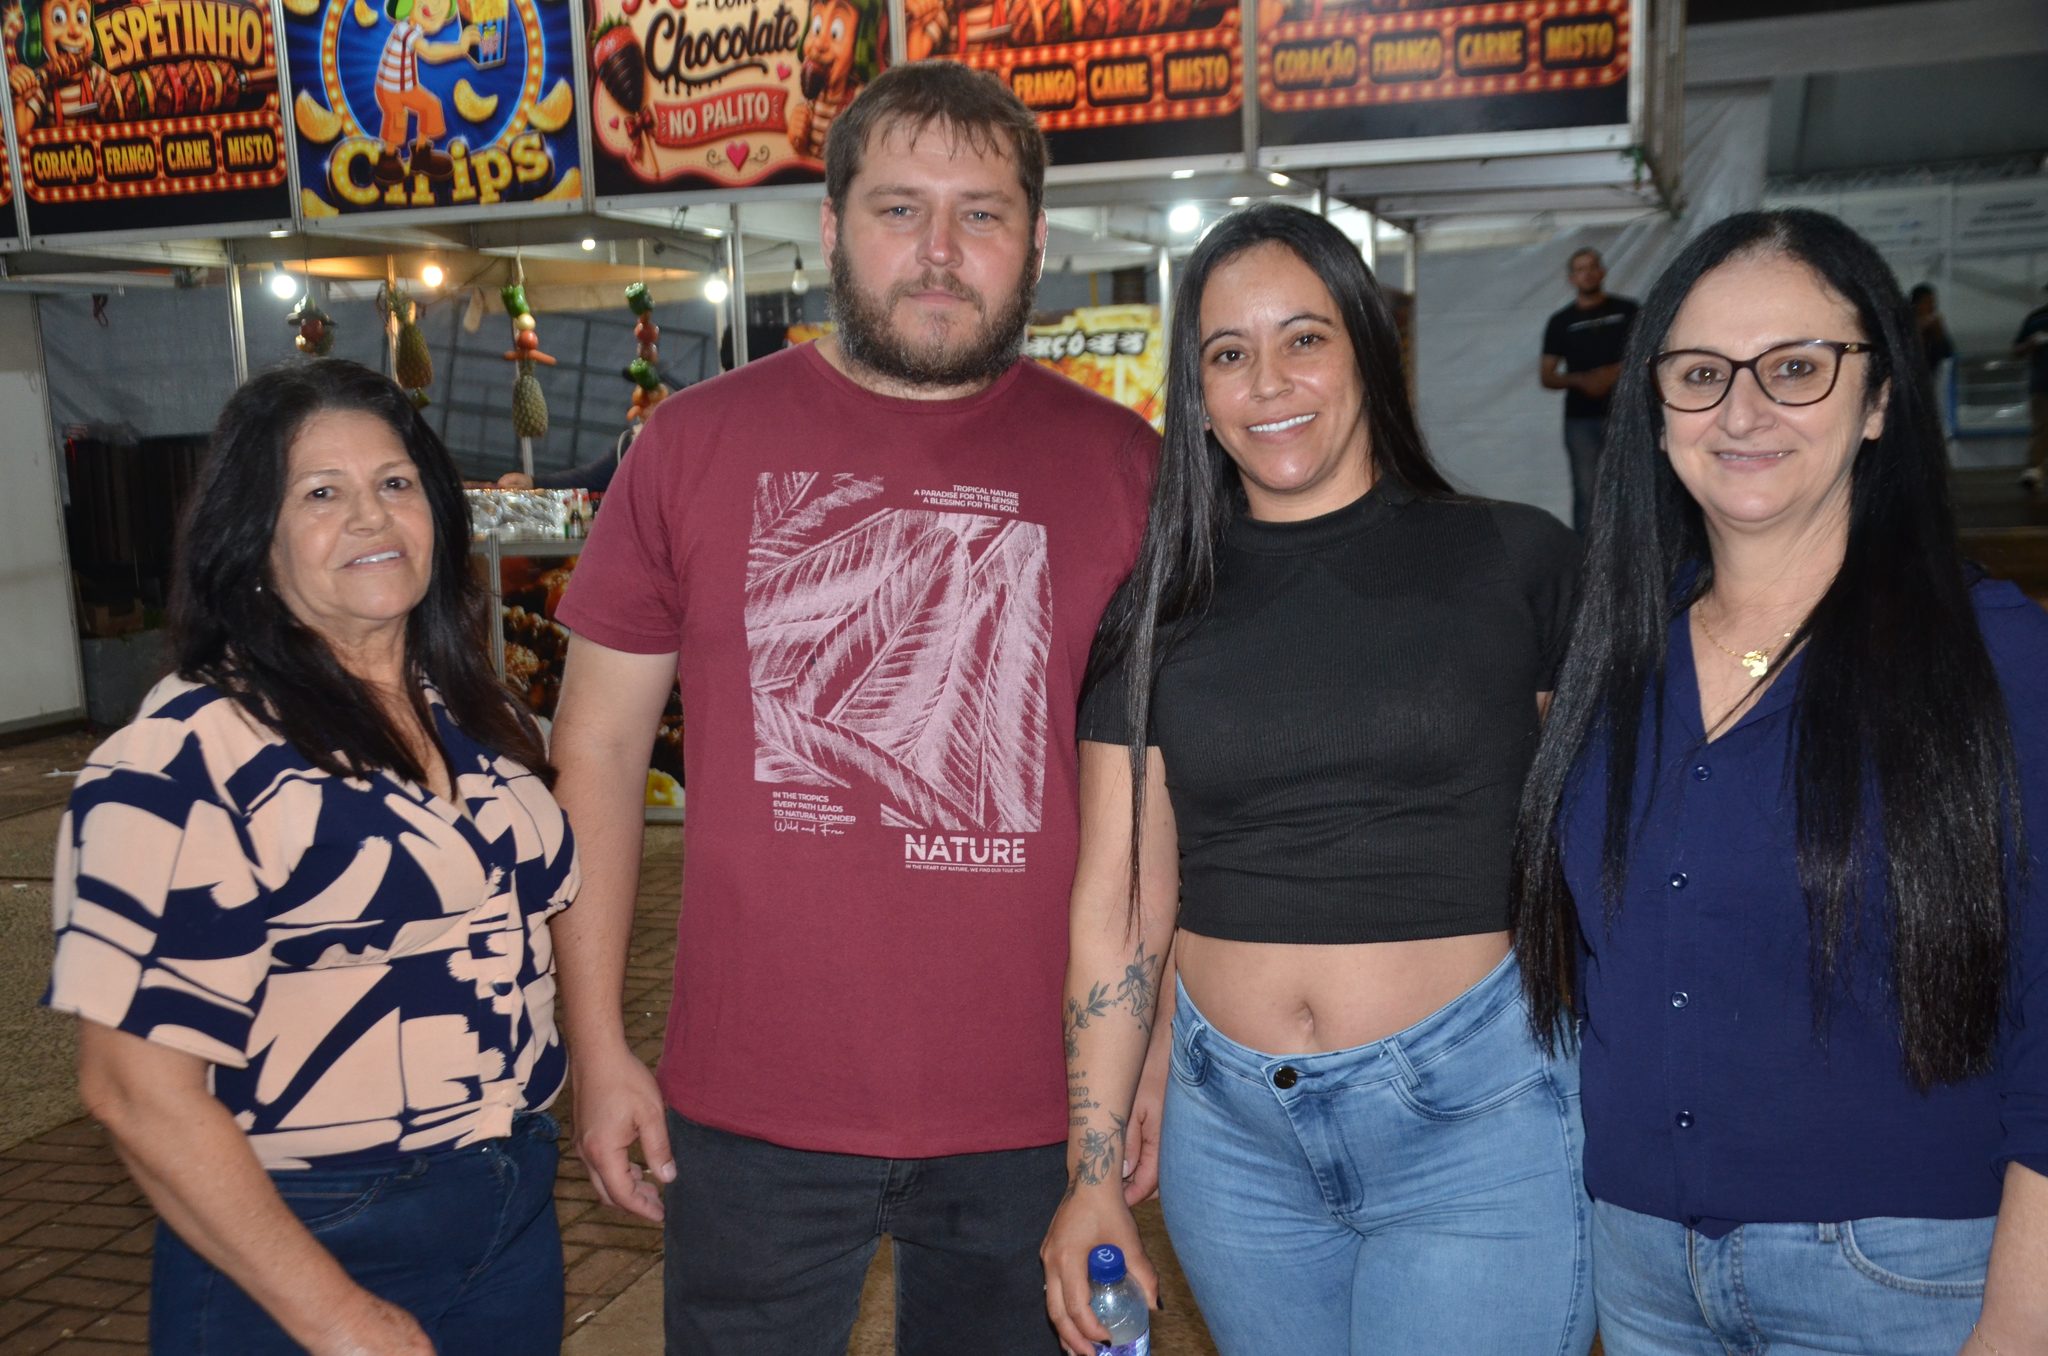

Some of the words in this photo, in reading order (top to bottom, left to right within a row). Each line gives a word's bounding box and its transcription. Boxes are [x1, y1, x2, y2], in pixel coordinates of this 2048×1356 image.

[95, 0, 263, 71] ESPETINHO
[645, 5, 799, 84] Chocolate
[1274, 39, 1356, 86] CORAÇÃO
[1372, 36, 1441, 76] FRANGO
[1458, 28, 1523, 66] CARNE
[1545, 22, 1614, 60] MISTO
[1013, 69, 1076, 104] FRANGO
[1089, 62, 1148, 100] CARNE
[1167, 54, 1229, 92] MISTO
[669, 107, 697, 138] NO
[702, 91, 770, 132] PALITO
[33, 144, 94, 183] CORAÇÃO
[104, 144, 155, 176] FRANGO
[166, 139, 212, 170] CARNE
[227, 134, 274, 166] MISTO
[920, 489, 958, 499] PARADISE
[959, 492, 975, 500] FOR
[976, 494, 991, 502] THE
[991, 496, 1019, 507] SENSES
[952, 484, 988, 494] TROPICAL
[990, 489, 1019, 499] NATURE
[922, 496, 929, 504] A
[930, 497, 966, 507] BLESSING
[967, 500, 983, 508] FOR
[984, 502, 998, 510] THE
[999, 504, 1019, 514] SOUL
[773, 800, 797, 808] EVERY
[798, 802, 816, 810] PATH
[817, 804, 844, 813] LEADS
[782, 792, 797, 800] THE
[797, 793, 829, 803] TROPICS
[774, 819, 799, 833] Wild
[801, 824, 816, 835] and
[785, 810, 817, 820] NATURAL
[819, 813, 856, 822] WONDER
[905, 833, 1026, 864] NATURE
